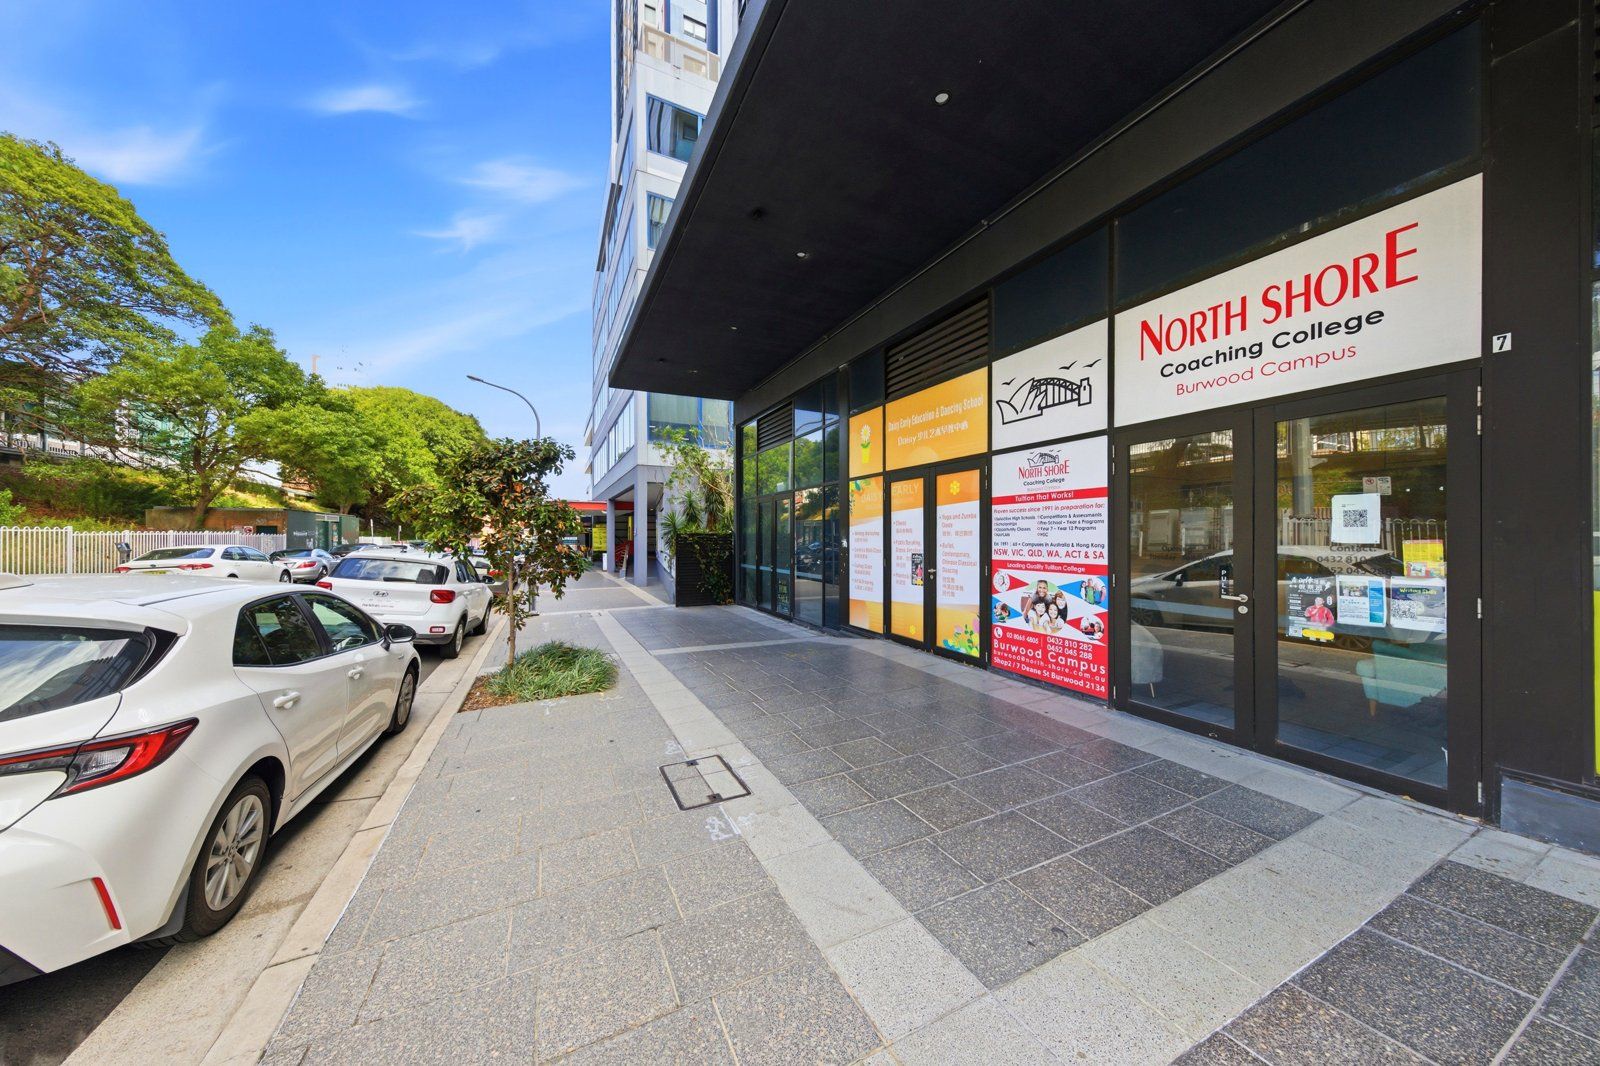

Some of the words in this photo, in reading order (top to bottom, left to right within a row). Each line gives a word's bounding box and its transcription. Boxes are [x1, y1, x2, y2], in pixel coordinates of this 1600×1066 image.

[1140, 295, 1247, 361] NORTH
[1261, 222, 1419, 324] SHORE
[1160, 341, 1263, 378] Coaching
[1272, 310, 1385, 349] College
[1495, 334, 1509, 351] 7
[1176, 366, 1254, 396] Burwood
[1260, 345, 1357, 377] Campus
[900, 418, 911, 428] Early
[912, 410, 934, 424] Education
[936, 409, 940, 418] &
[940, 404, 962, 416] Dancing
[963, 396, 984, 410] School
[1018, 466, 1042, 480] NORTH
[1044, 460, 1070, 477] SHORE
[1050, 491, 1074, 499] Works!
[1060, 504, 1094, 512] preparation
[1028, 549, 1045, 558] QLD,
[1046, 550, 1062, 558] WA,
[1064, 550, 1082, 559] ACT
[1084, 551, 1089, 559] &
[1093, 551, 1104, 559] SA
[994, 640, 1042, 659] Burwood
[1048, 652, 1106, 674] Campus
[1046, 636, 1063, 646] 0432
[1064, 639, 1077, 649] 810
[1079, 642, 1092, 652] 282
[1046, 644, 1063, 654] 0452
[1064, 647, 1077, 657] 045
[1079, 650, 1092, 660] 288
[994, 650, 1105, 682] burwood@north-shore.com.au
[994, 657, 1012, 667] Shop2
[1021, 664, 1041, 675] Deane
[1051, 672, 1084, 687] Burwood
[1086, 681, 1105, 692] 2134
